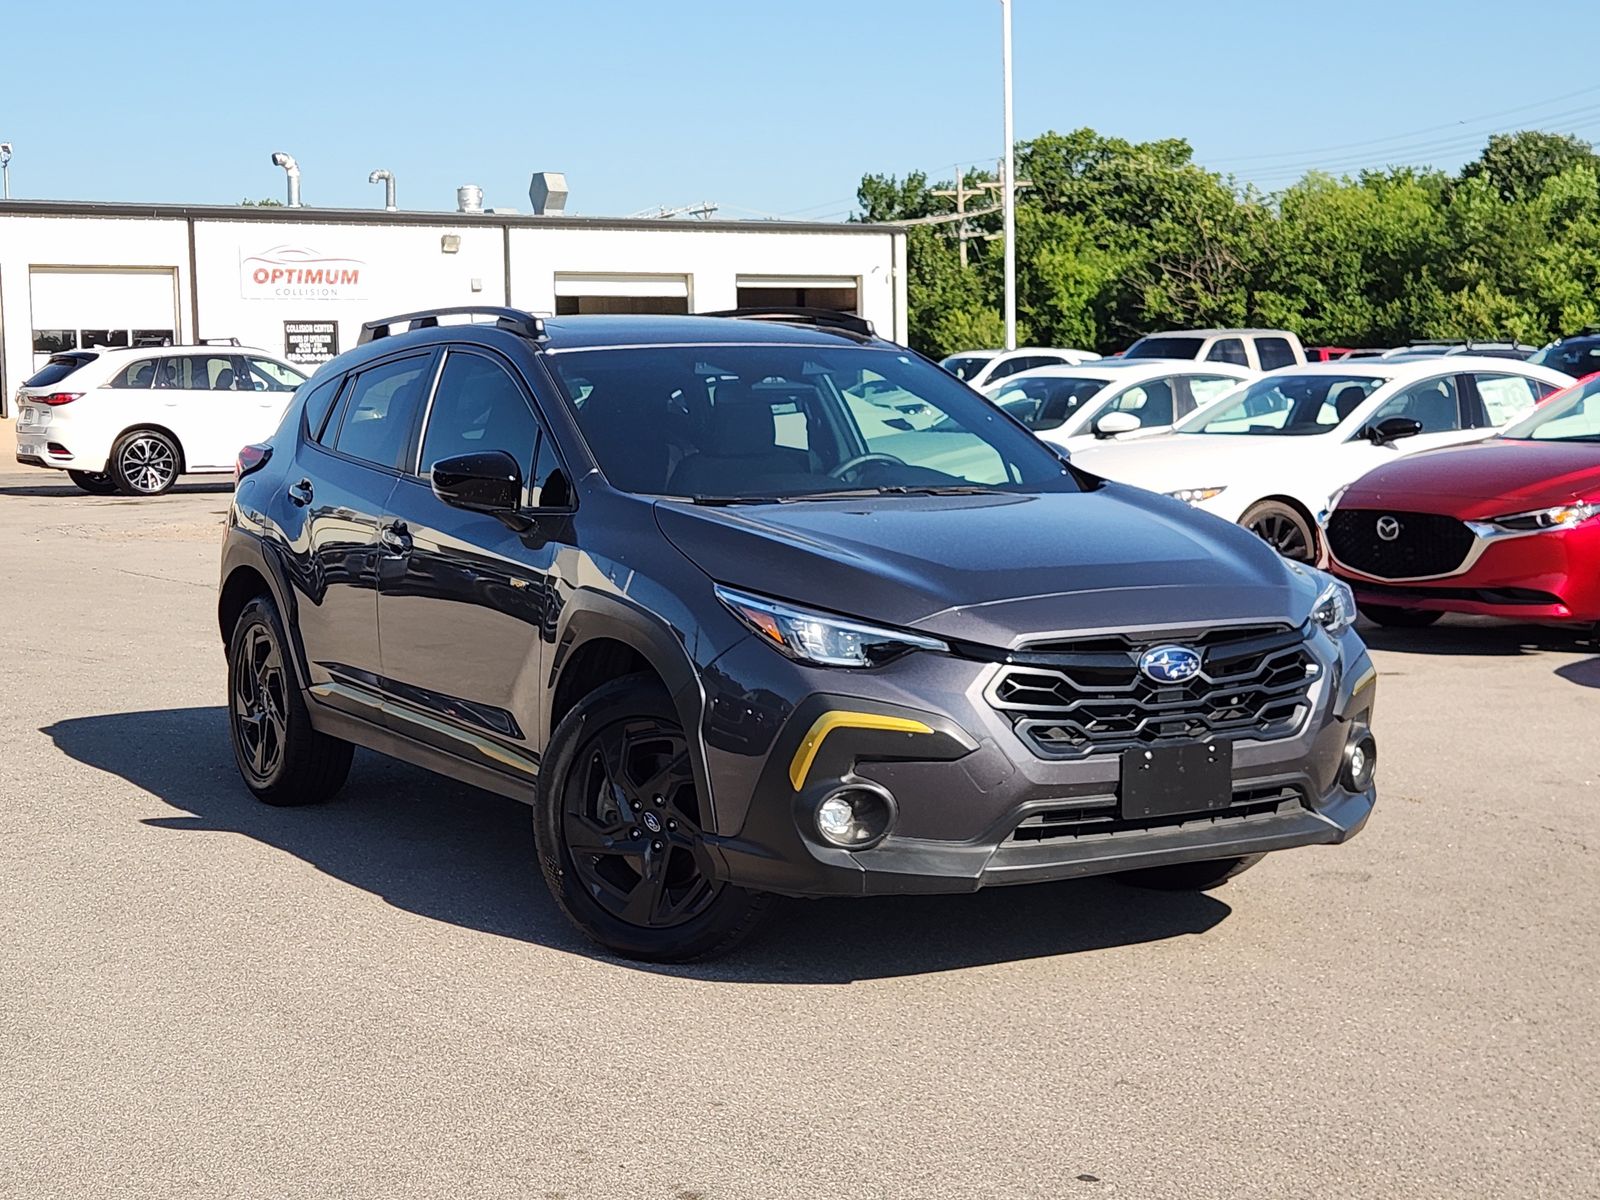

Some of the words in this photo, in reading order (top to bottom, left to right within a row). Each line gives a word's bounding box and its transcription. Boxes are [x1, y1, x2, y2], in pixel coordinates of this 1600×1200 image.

[253, 267, 359, 284] OPTIMUM
[275, 288, 338, 296] COLLISION
[286, 324, 313, 333] COLLISION
[314, 324, 334, 333] CENTER
